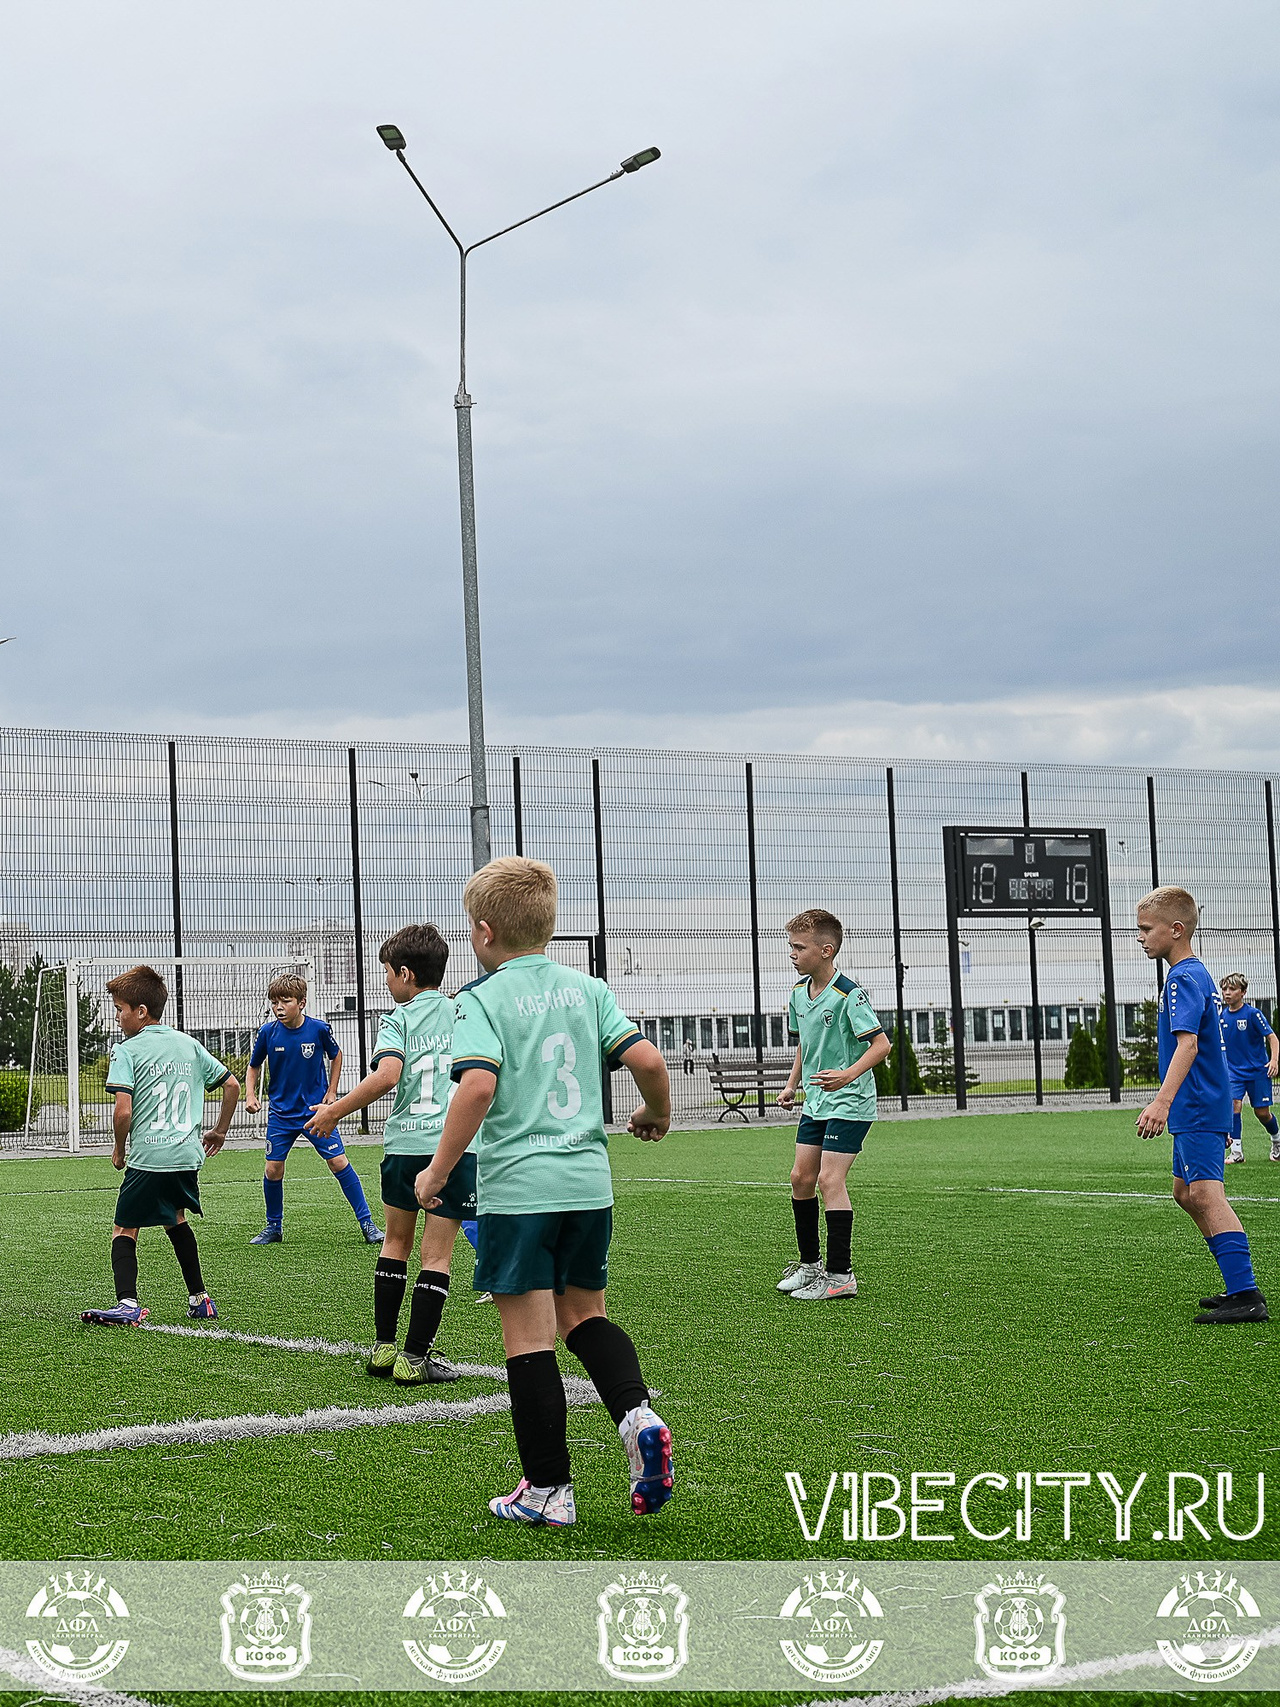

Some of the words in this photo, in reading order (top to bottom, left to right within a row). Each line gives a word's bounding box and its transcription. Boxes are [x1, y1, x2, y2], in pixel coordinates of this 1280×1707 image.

[515, 987, 586, 1017] КАБАНОВ
[541, 1032, 582, 1120] 3
[150, 1081, 193, 1132] 10
[528, 1134, 547, 1147] СШ
